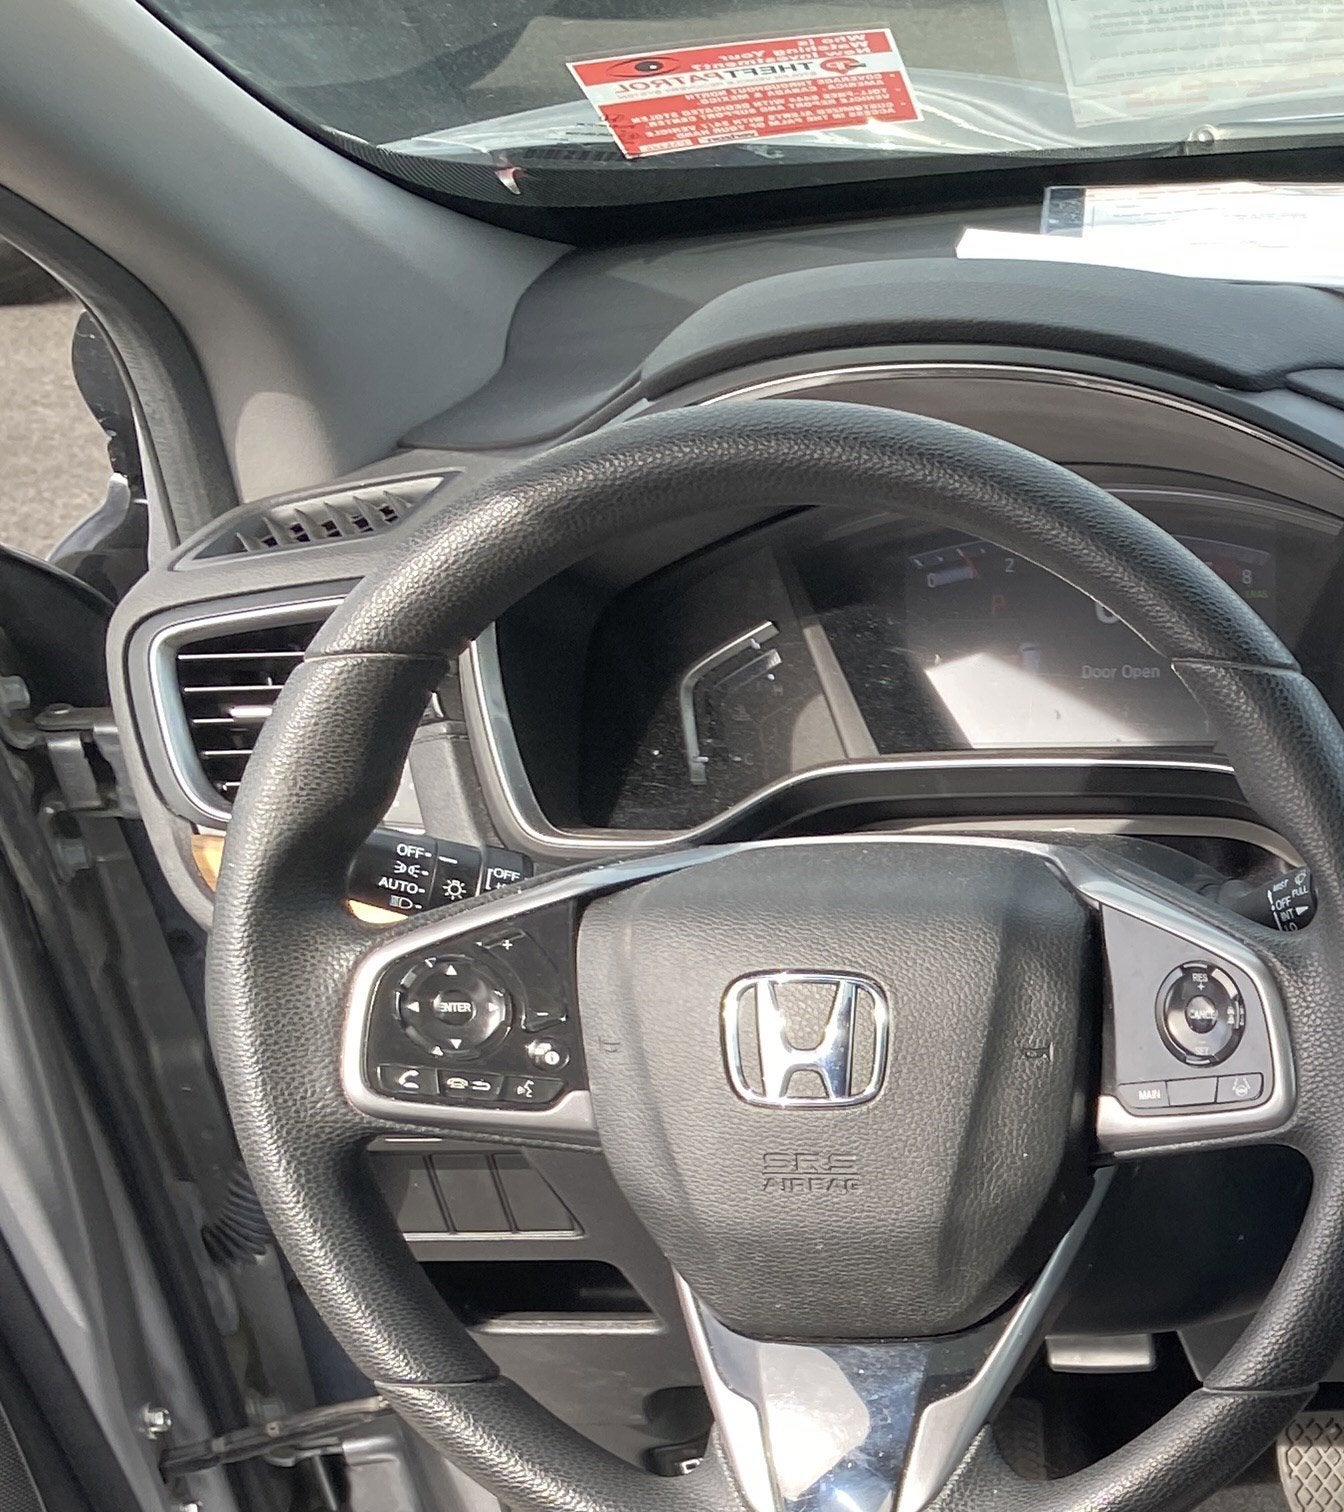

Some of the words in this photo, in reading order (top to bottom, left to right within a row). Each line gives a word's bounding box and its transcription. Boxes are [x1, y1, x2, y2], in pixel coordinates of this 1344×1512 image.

[1081, 664, 1118, 680] Door
[1122, 664, 1161, 681] Open
[396, 843, 425, 859] OFF
[492, 867, 521, 882] OFF
[378, 876, 419, 895] AUTO
[1275, 896, 1292, 911] OFF
[1192, 973, 1208, 982] RES
[1138, 1088, 1161, 1100] MAIN
[762, 1152, 857, 1172] SRS
[763, 1177, 860, 1193] AIRBAG
